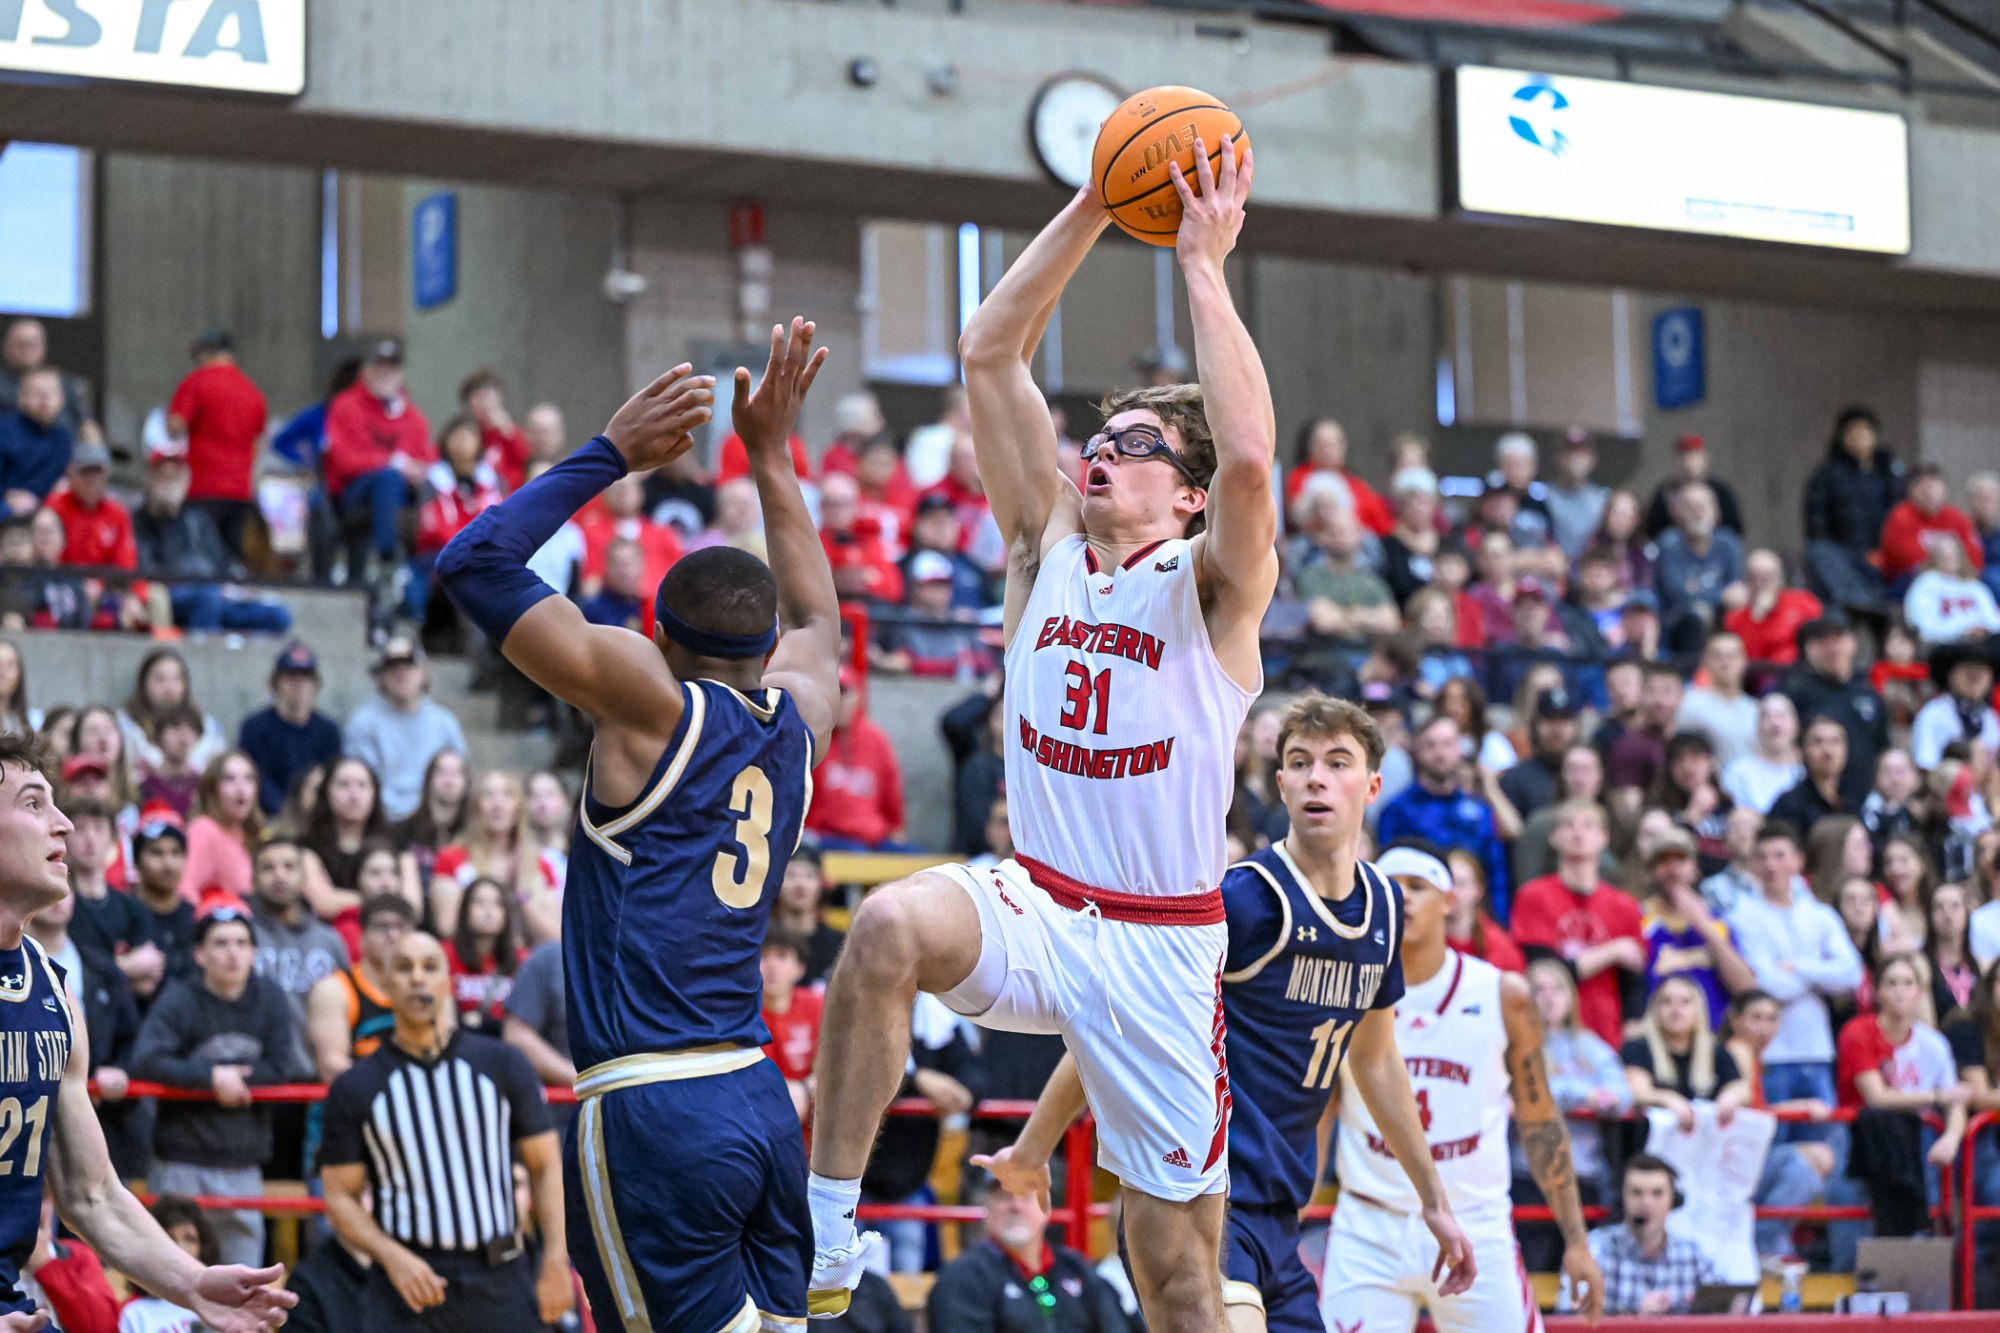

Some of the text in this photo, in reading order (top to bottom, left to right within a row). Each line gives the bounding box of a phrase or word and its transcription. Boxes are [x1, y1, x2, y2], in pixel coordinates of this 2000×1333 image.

[1130, 121, 1199, 184] EVO NXT
[1034, 615, 1166, 671] EASTERN
[1060, 660, 1112, 735] 31
[1019, 714, 1175, 779] WASHINGTON
[712, 765, 774, 909] 3
[1284, 954, 1354, 1009] MONTANA
[1302, 1018, 1354, 1089] 11
[0, 1095, 49, 1177] 21
[1162, 1155, 1192, 1169] adidas
